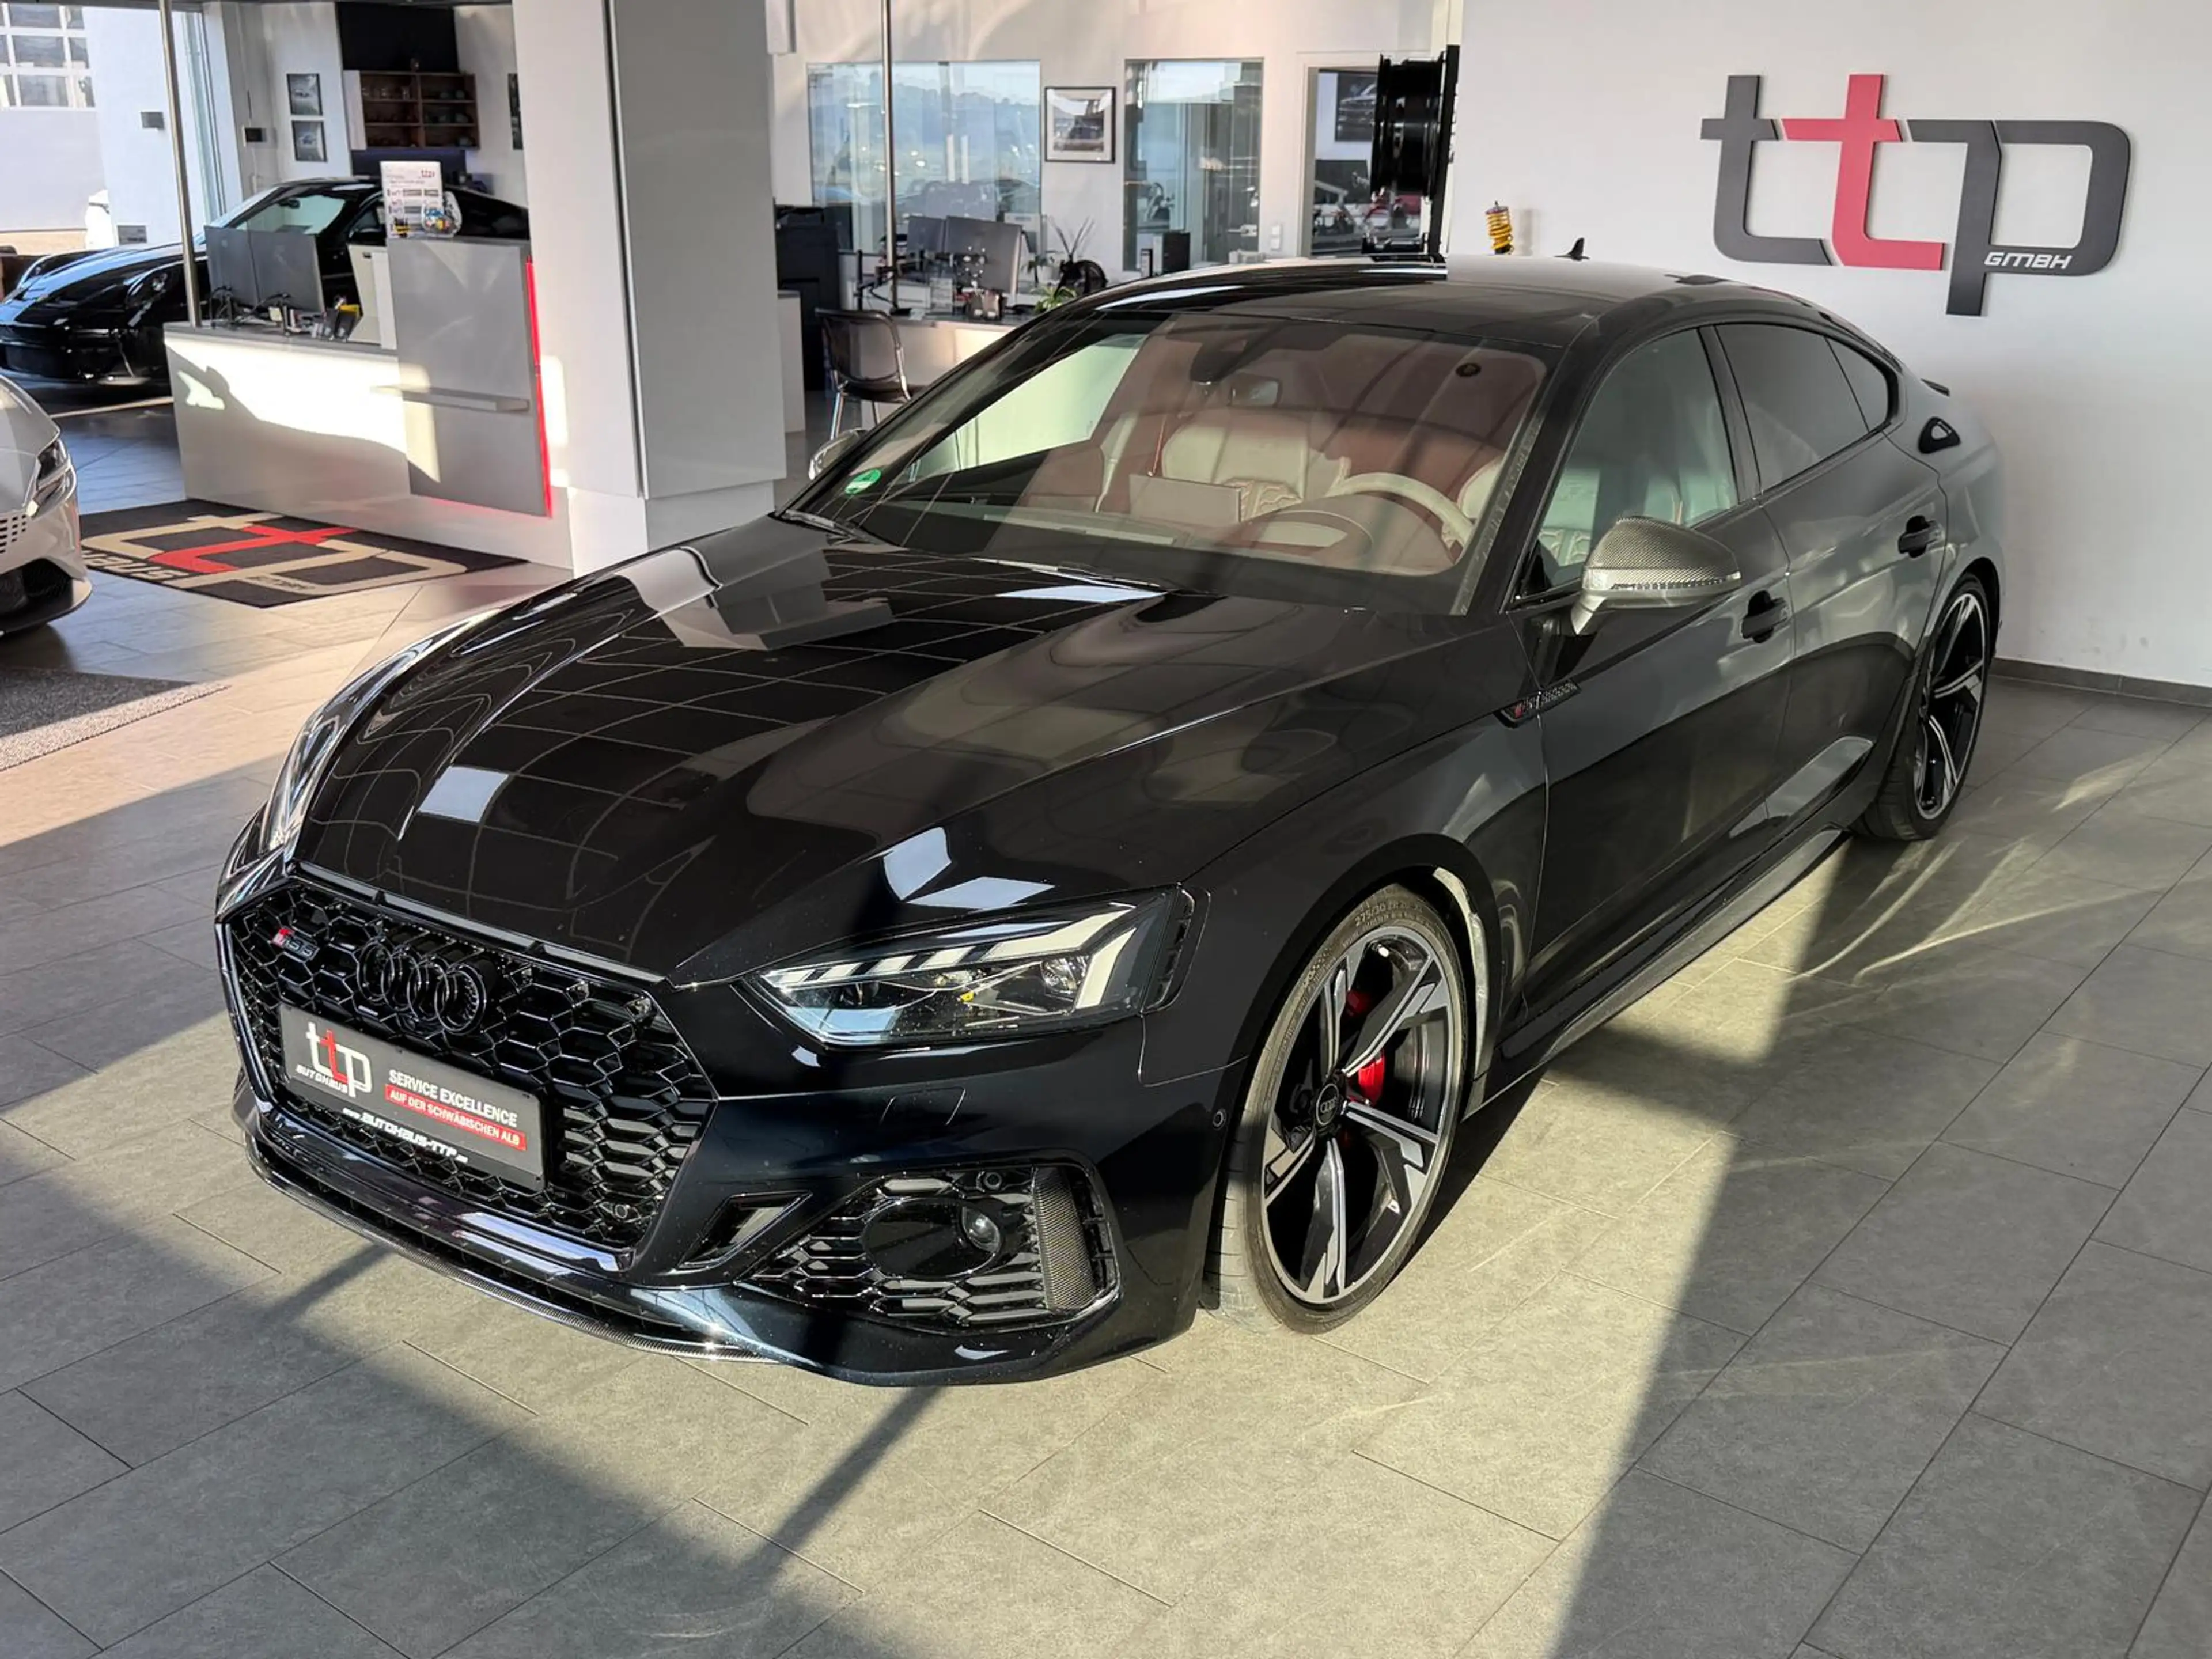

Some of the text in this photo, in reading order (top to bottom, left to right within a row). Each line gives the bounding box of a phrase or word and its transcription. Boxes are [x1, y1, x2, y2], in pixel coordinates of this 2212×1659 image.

[1701, 74, 2131, 316] ttp
[1984, 252, 2072, 270] GMBH
[305, 1021, 372, 1098] ttp
[388, 1069, 518, 1128] SERVICE EXCELLENCE
[390, 1089, 520, 1146] AUF DER SCHWÄBISCHEN ALB
